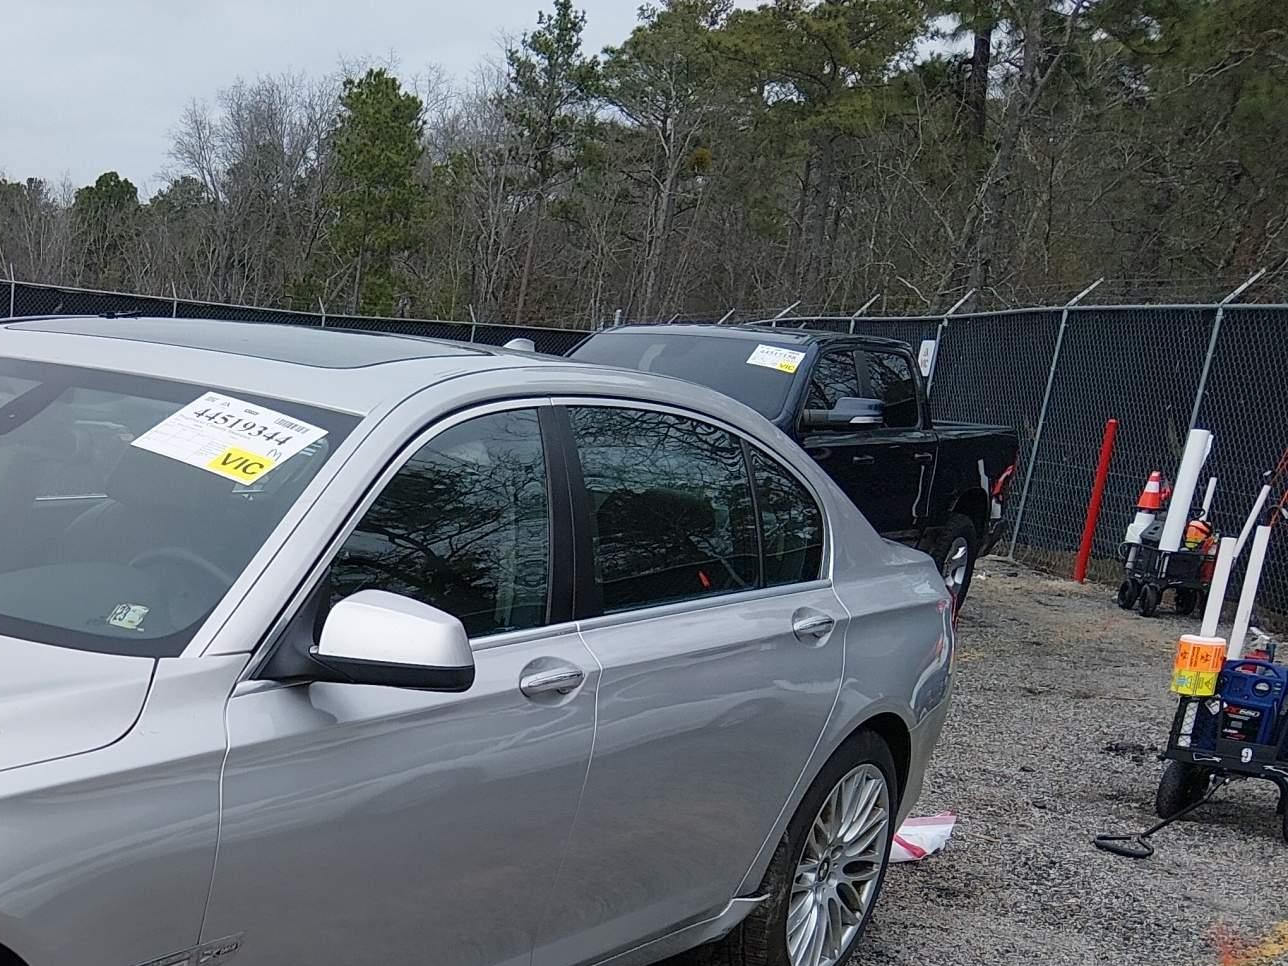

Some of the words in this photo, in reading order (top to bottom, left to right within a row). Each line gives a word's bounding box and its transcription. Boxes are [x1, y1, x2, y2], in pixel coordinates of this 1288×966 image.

[194, 408, 293, 446] 44519344
[221, 453, 264, 475] VIC
[1241, 747, 1253, 763] 9
